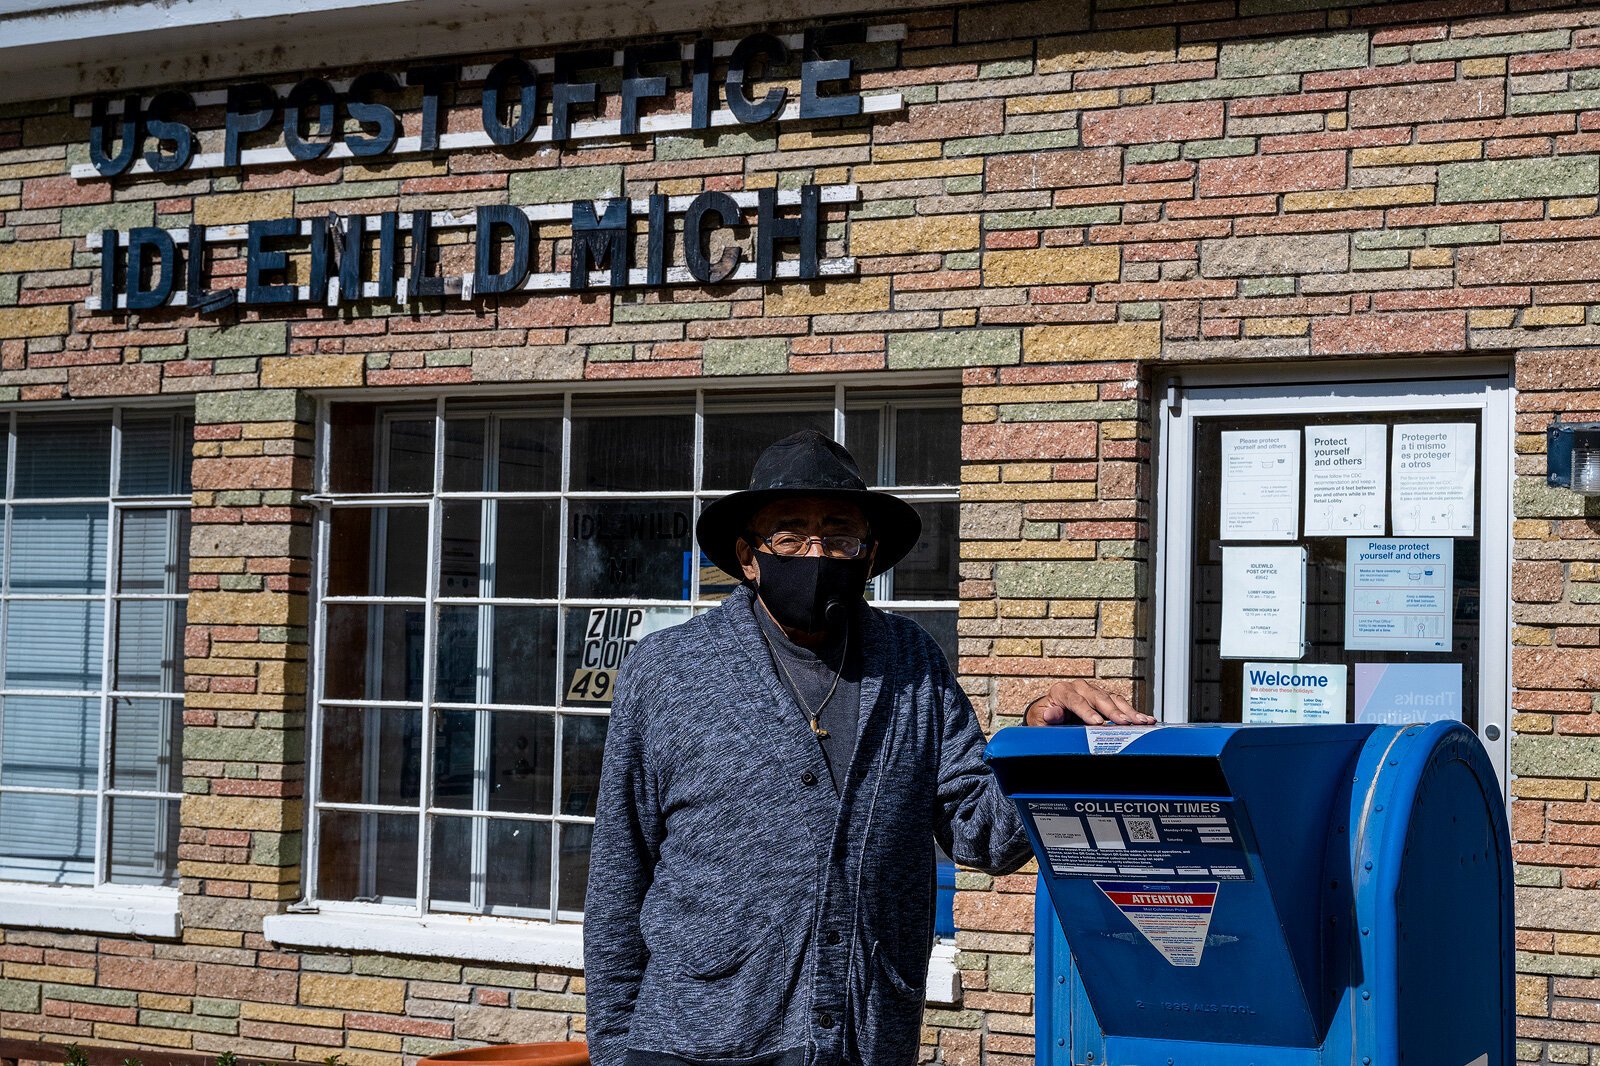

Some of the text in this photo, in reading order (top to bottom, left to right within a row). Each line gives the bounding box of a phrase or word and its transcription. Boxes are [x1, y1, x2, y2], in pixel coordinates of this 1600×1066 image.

[89, 25, 868, 177] US POST OFFICE
[101, 183, 821, 312] IDLEWILD MICH
[1314, 438, 1347, 446] Protect
[1401, 433, 1447, 442] Protegerte
[1234, 443, 1255, 451] yourself
[1409, 442, 1414, 450] ti
[1314, 448, 1350, 458] yourself
[1413, 451, 1451, 460] proteger
[1314, 458, 1331, 466] and
[574, 512, 689, 540] IDLEWILD
[1369, 542, 1429, 551] Please protect
[1360, 552, 1393, 561] yourself
[1413, 552, 1440, 560] others
[587, 609, 643, 638] ZIP
[1249, 670, 1328, 687] Welcome
[1074, 802, 1221, 813] COLLECTION TIMES
[1132, 894, 1194, 905] ATTENTION
